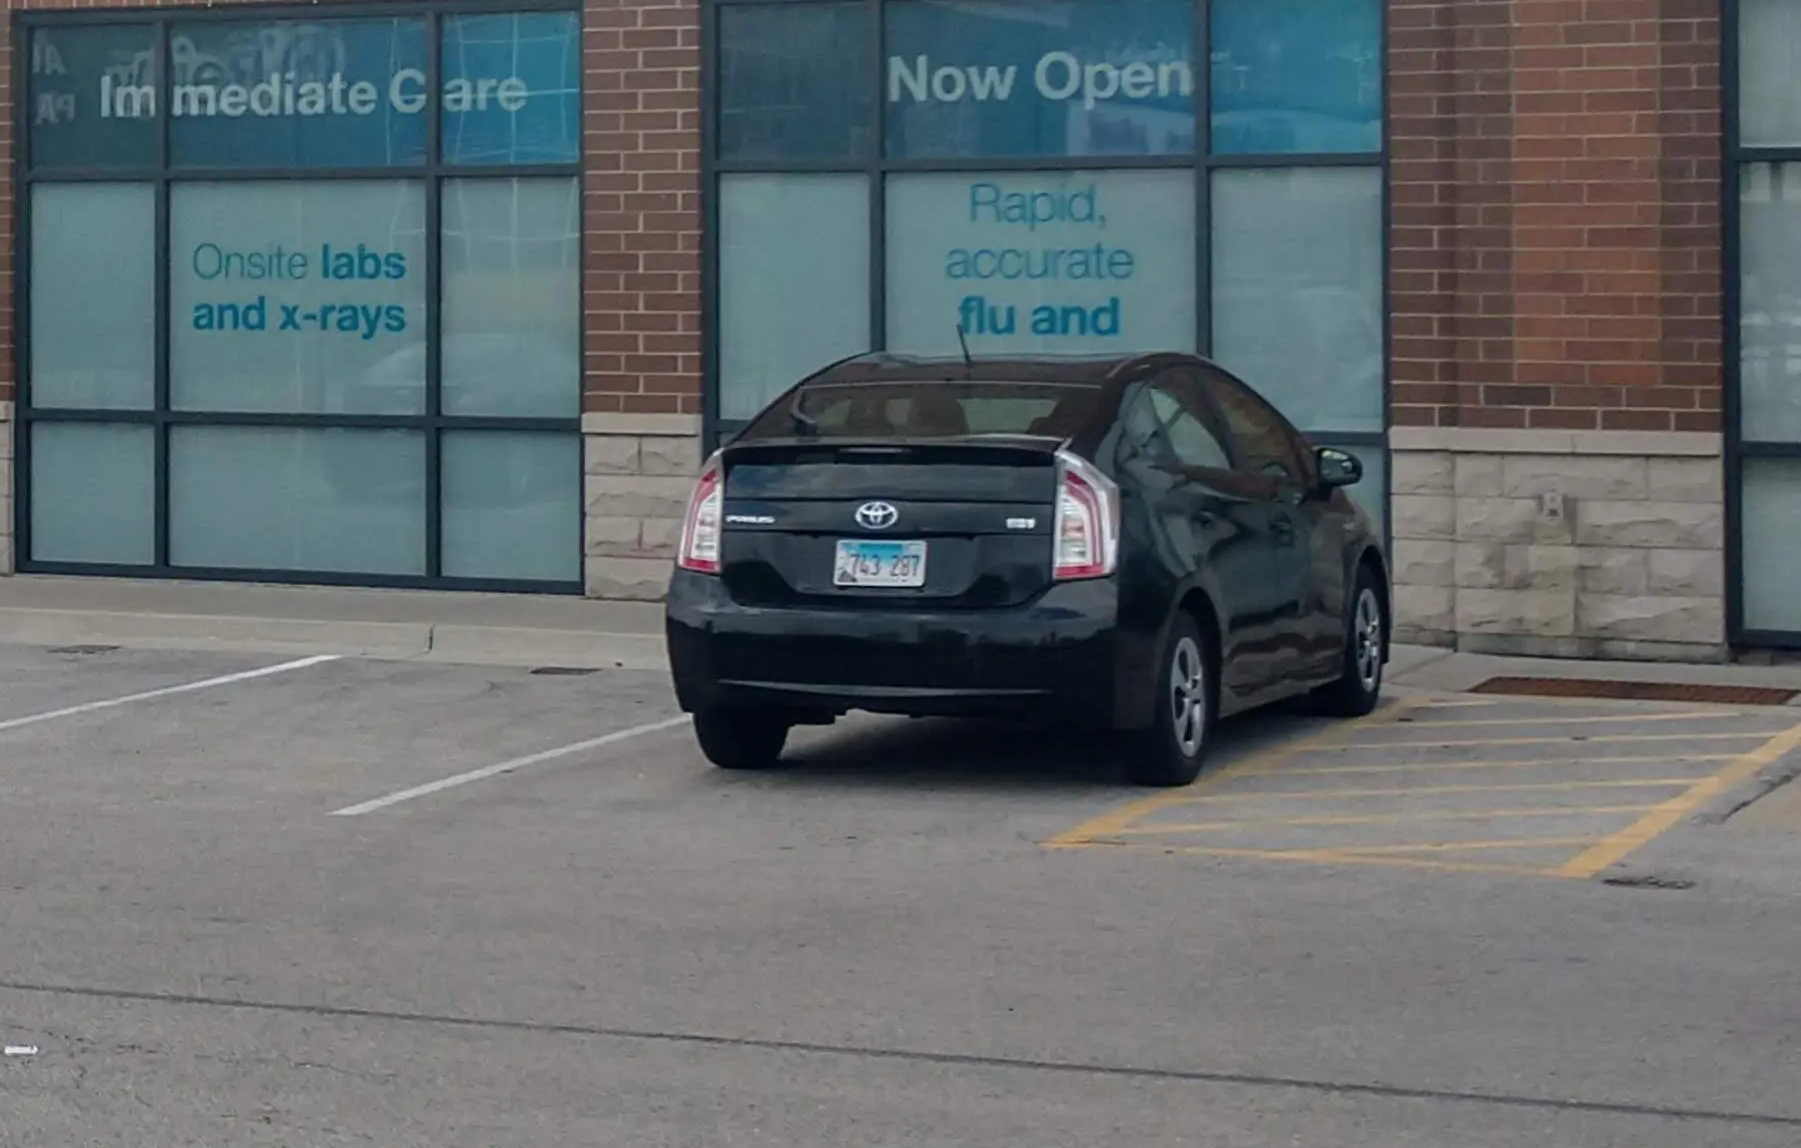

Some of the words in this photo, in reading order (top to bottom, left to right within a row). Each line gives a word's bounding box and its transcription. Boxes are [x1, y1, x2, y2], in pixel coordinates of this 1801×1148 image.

[100, 71, 378, 119] Immediate
[389, 68, 528, 114] Care
[887, 54, 1018, 103] Now
[1034, 50, 1193, 110] Open
[969, 183, 1107, 231] Rapid,
[192, 242, 309, 280] Onsite
[321, 243, 407, 280] labs
[944, 245, 1135, 280] accurate
[192, 296, 266, 331] and
[279, 301, 408, 340] x-rays
[959, 297, 1016, 335] flu
[1031, 296, 1120, 336] and
